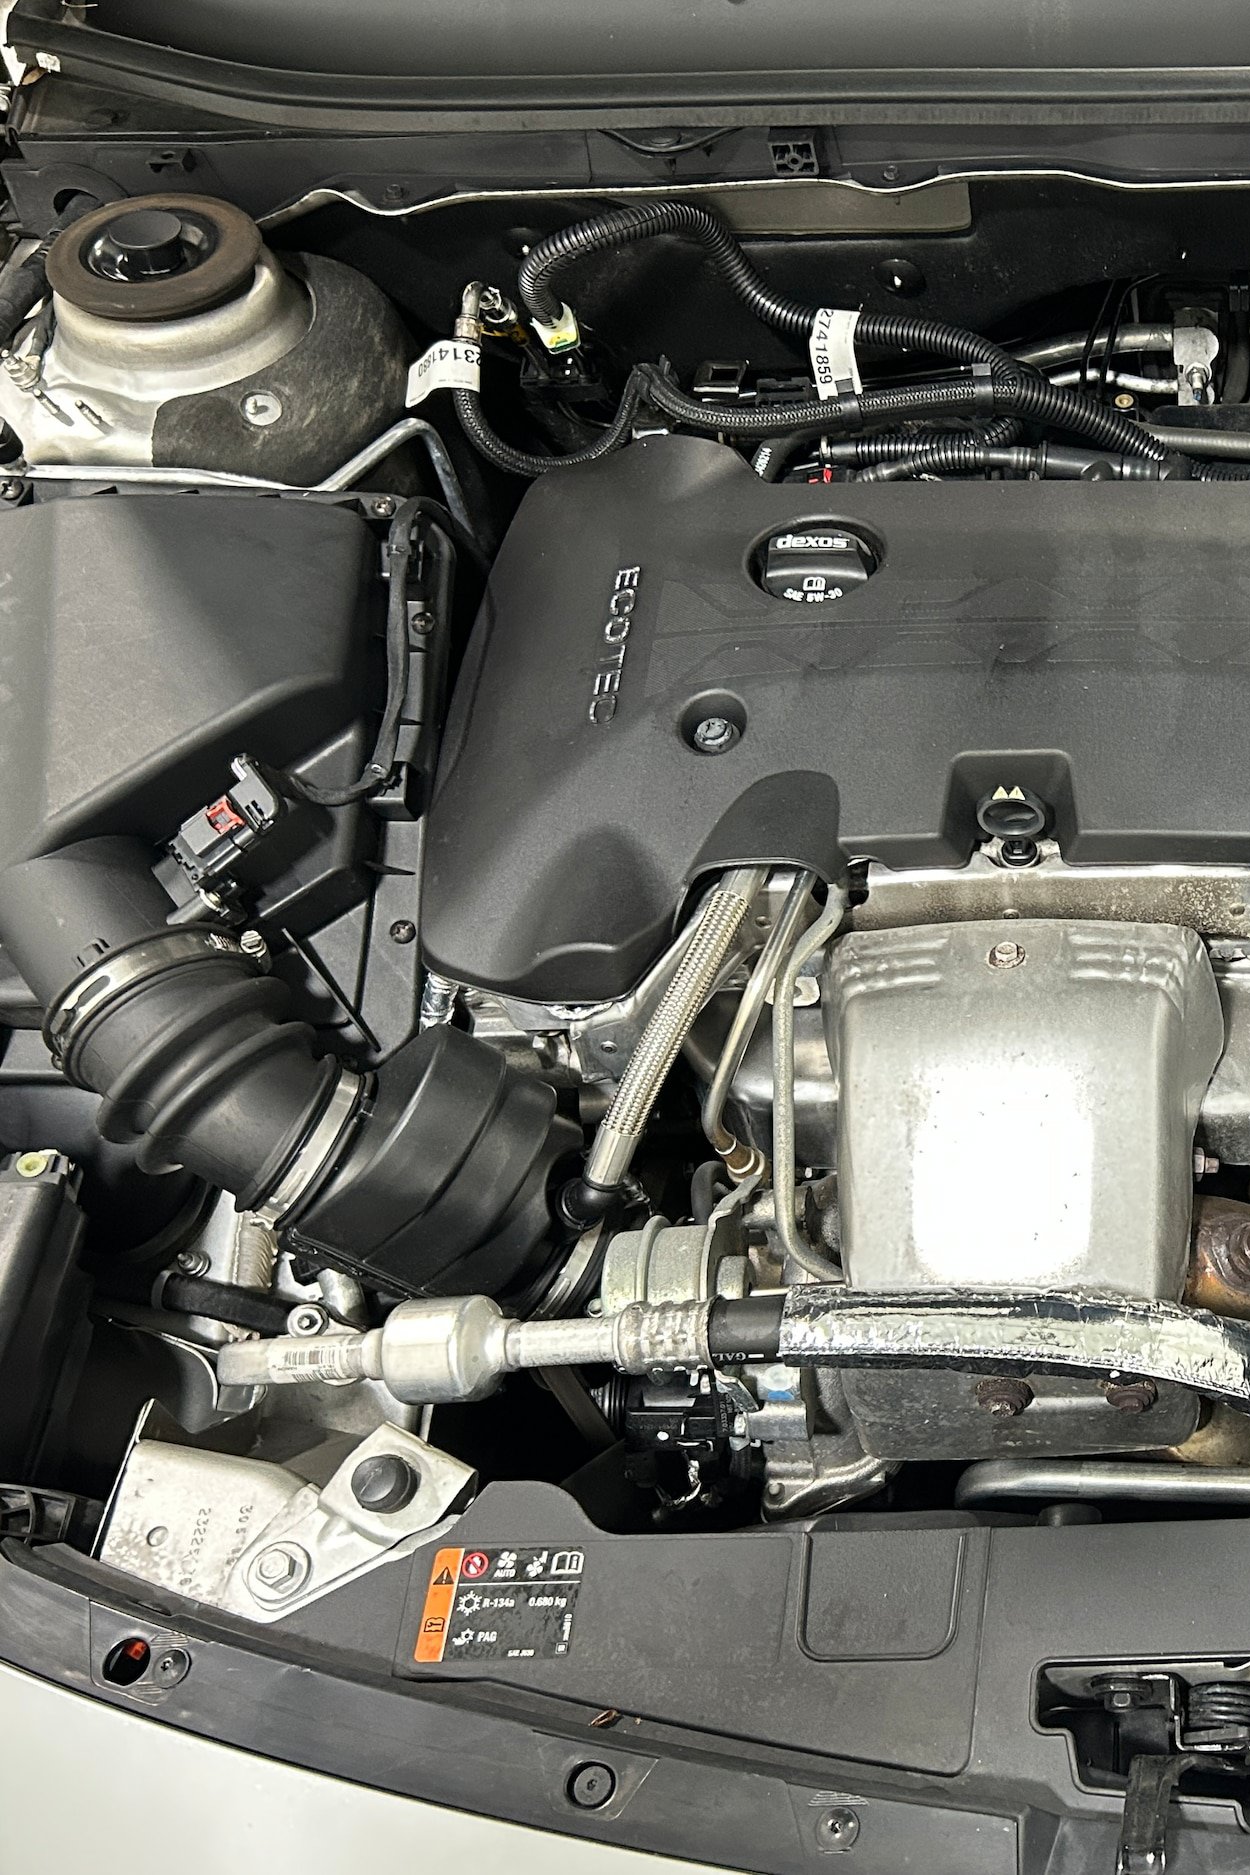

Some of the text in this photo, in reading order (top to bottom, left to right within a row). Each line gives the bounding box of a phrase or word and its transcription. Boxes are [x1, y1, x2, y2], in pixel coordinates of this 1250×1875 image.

[776, 534, 850, 549] dexos
[783, 587, 843, 603] SAE 5W-30
[589, 566, 641, 726] ECOTEC
[494, 1568, 516, 1578] AUTO
[482, 1597, 515, 1608] R-134a
[554, 1597, 568, 1608] kg
[477, 1631, 498, 1643] PAG
